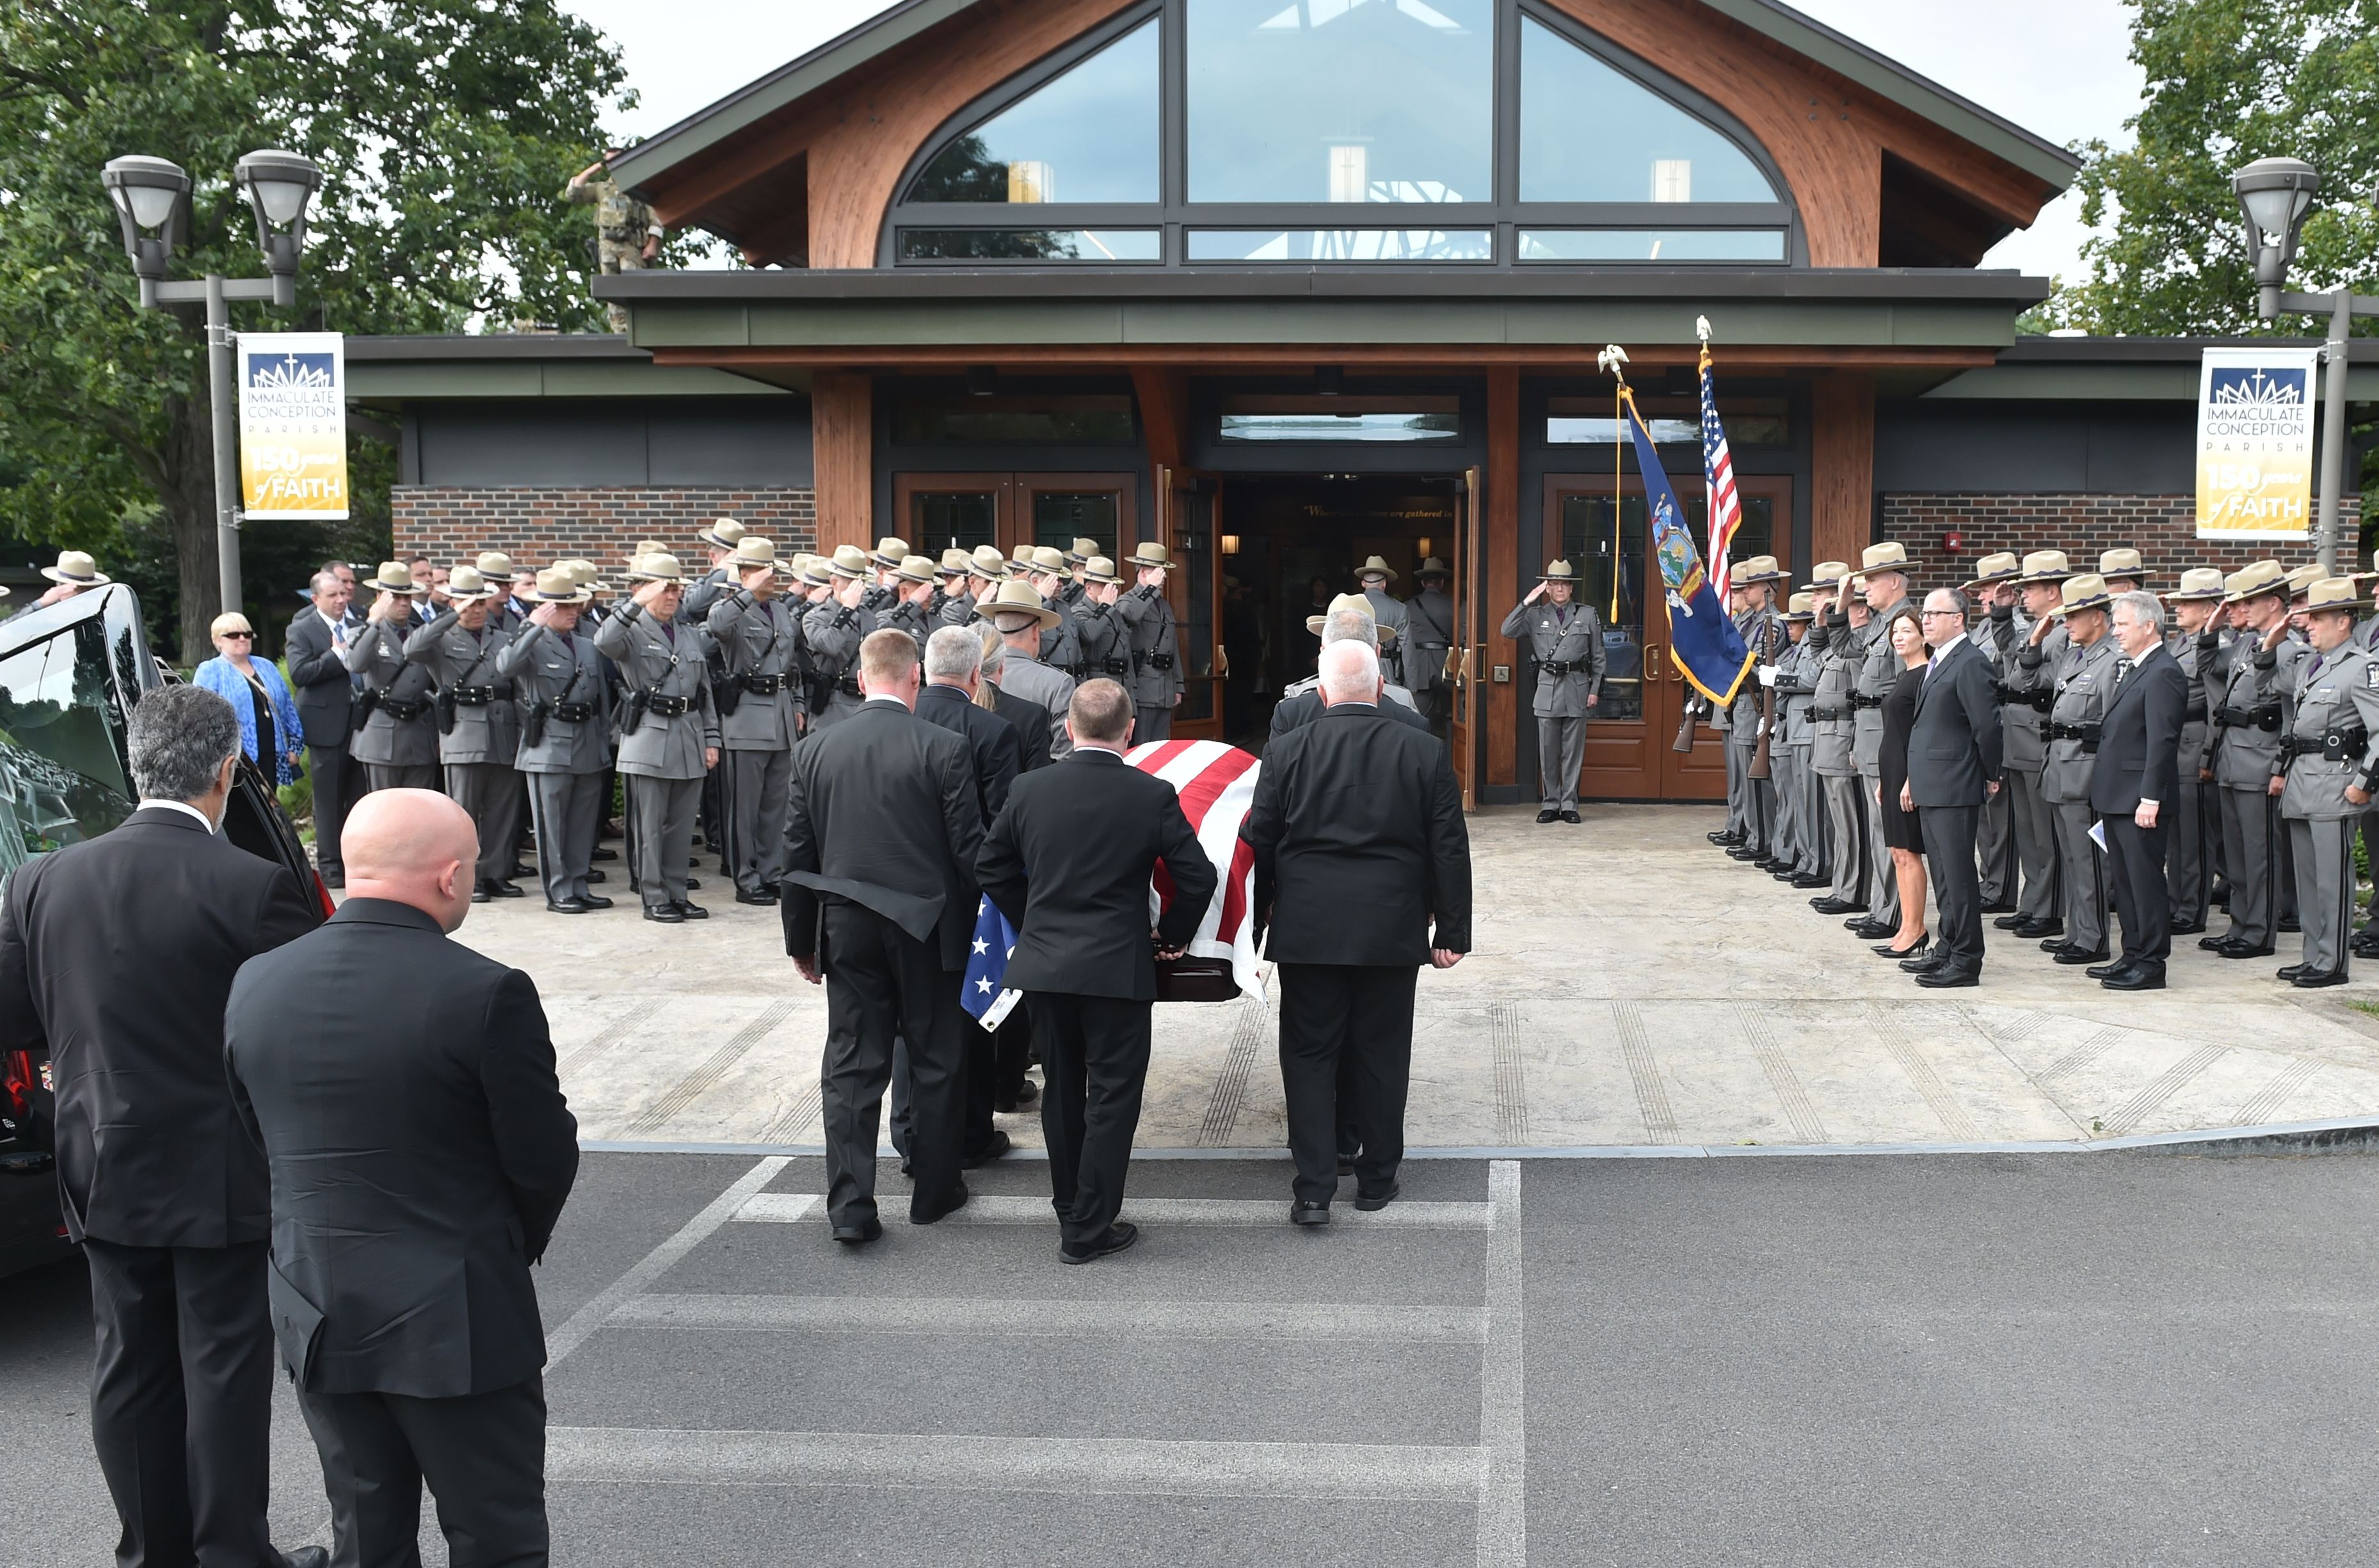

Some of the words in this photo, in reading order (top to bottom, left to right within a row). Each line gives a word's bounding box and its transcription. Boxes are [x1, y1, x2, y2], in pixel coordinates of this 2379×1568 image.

[248, 391, 335, 403] IMMACULATE
[248, 406, 335, 418] CONCEPTION
[2208, 408, 2304, 421] IMMACULATE
[248, 425, 337, 433] PARISH
[2207, 423, 2304, 436] CONCEPTION
[2206, 442, 2303, 452] PARISH
[248, 446, 300, 471] 150
[286, 453, 339, 477] years
[2205, 465, 2261, 490] 150
[2246, 472, 2303, 496] years
[248, 472, 284, 504] of
[272, 478, 340, 498] FAITH
[1405, 509, 1443, 519] gathered
[2200, 491, 2243, 524] of
[2229, 497, 2302, 518] FAITH
